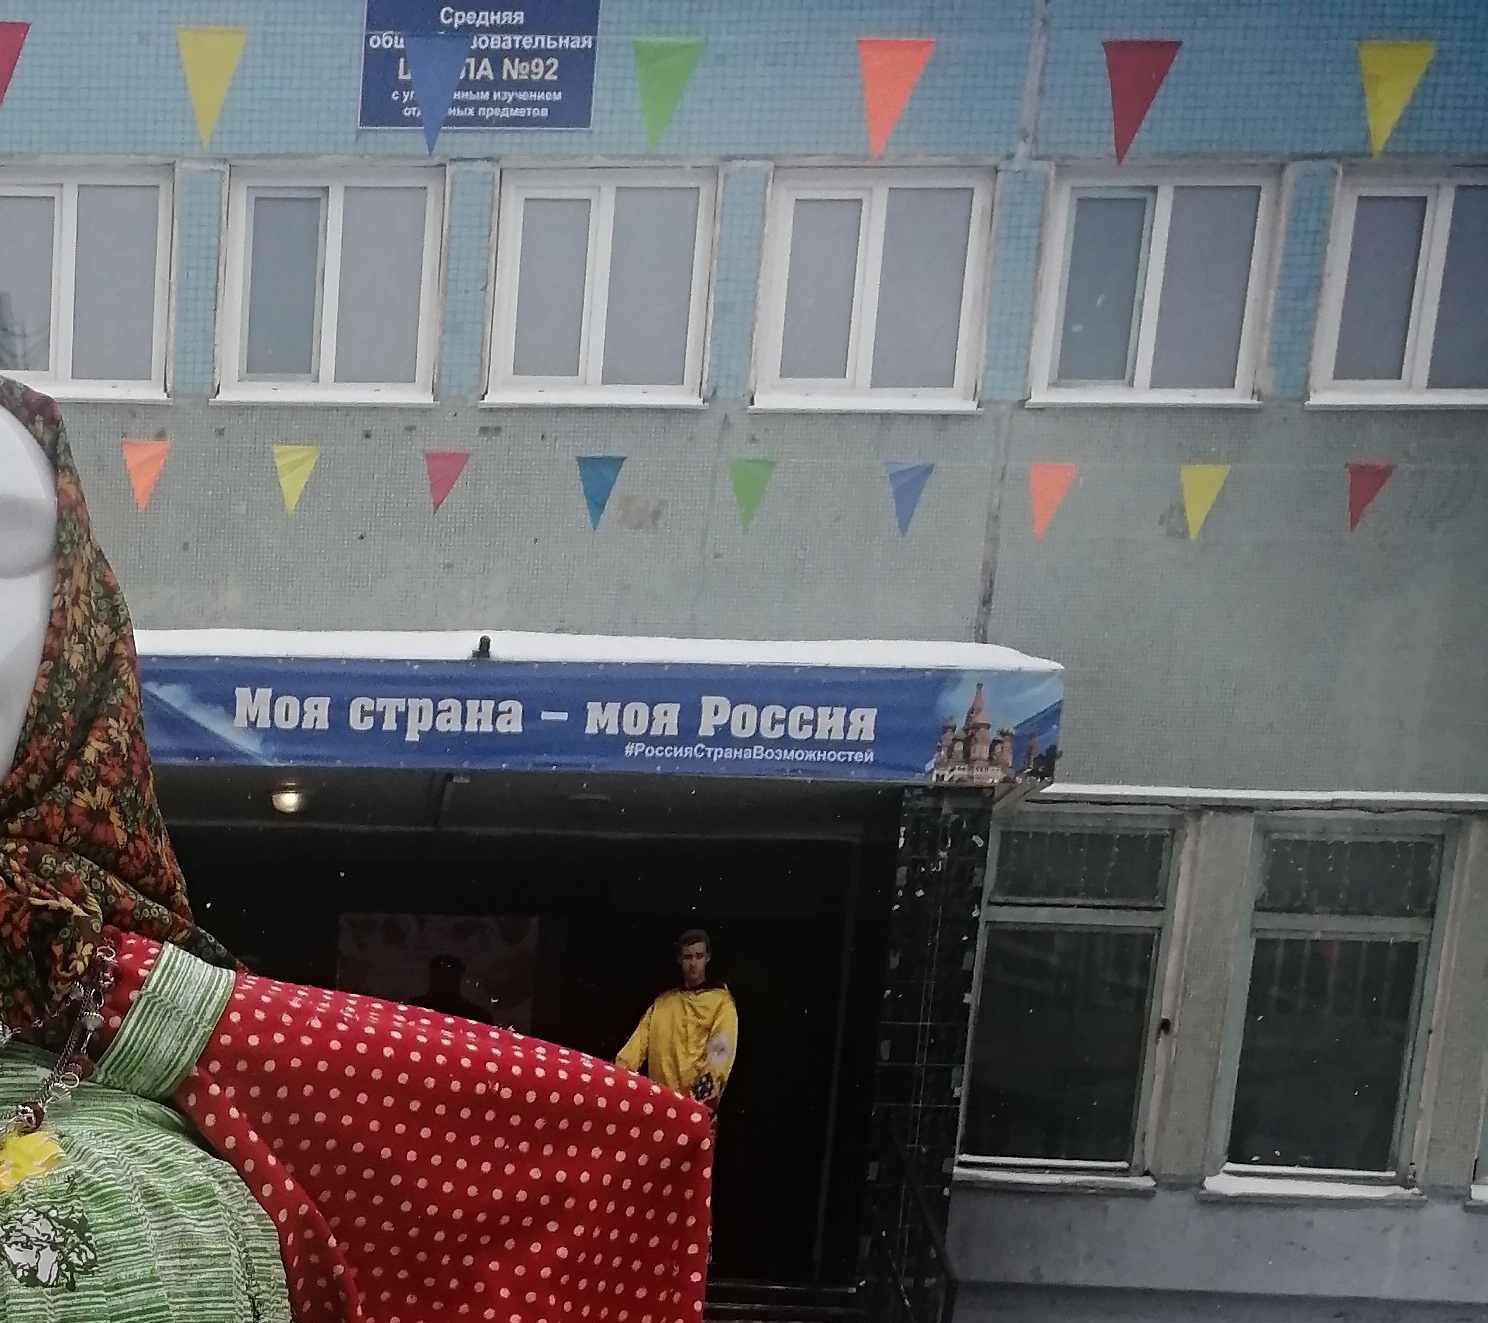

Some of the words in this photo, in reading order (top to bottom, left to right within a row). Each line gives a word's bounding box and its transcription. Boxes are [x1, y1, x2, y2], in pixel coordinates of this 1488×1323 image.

[439, 6, 525, 28] Средняя
[502, 57, 559, 81] №92
[391, 91, 400, 100] с
[493, 91, 563, 103] изучением
[478, 107, 549, 120] предметов
[233, 687, 331, 730] Моя
[348, 696, 524, 742] страна
[585, 701, 681, 736] моя
[698, 695, 879, 741] Россия
[623, 742, 875, 764] #РоссияСтранаВозможностей
